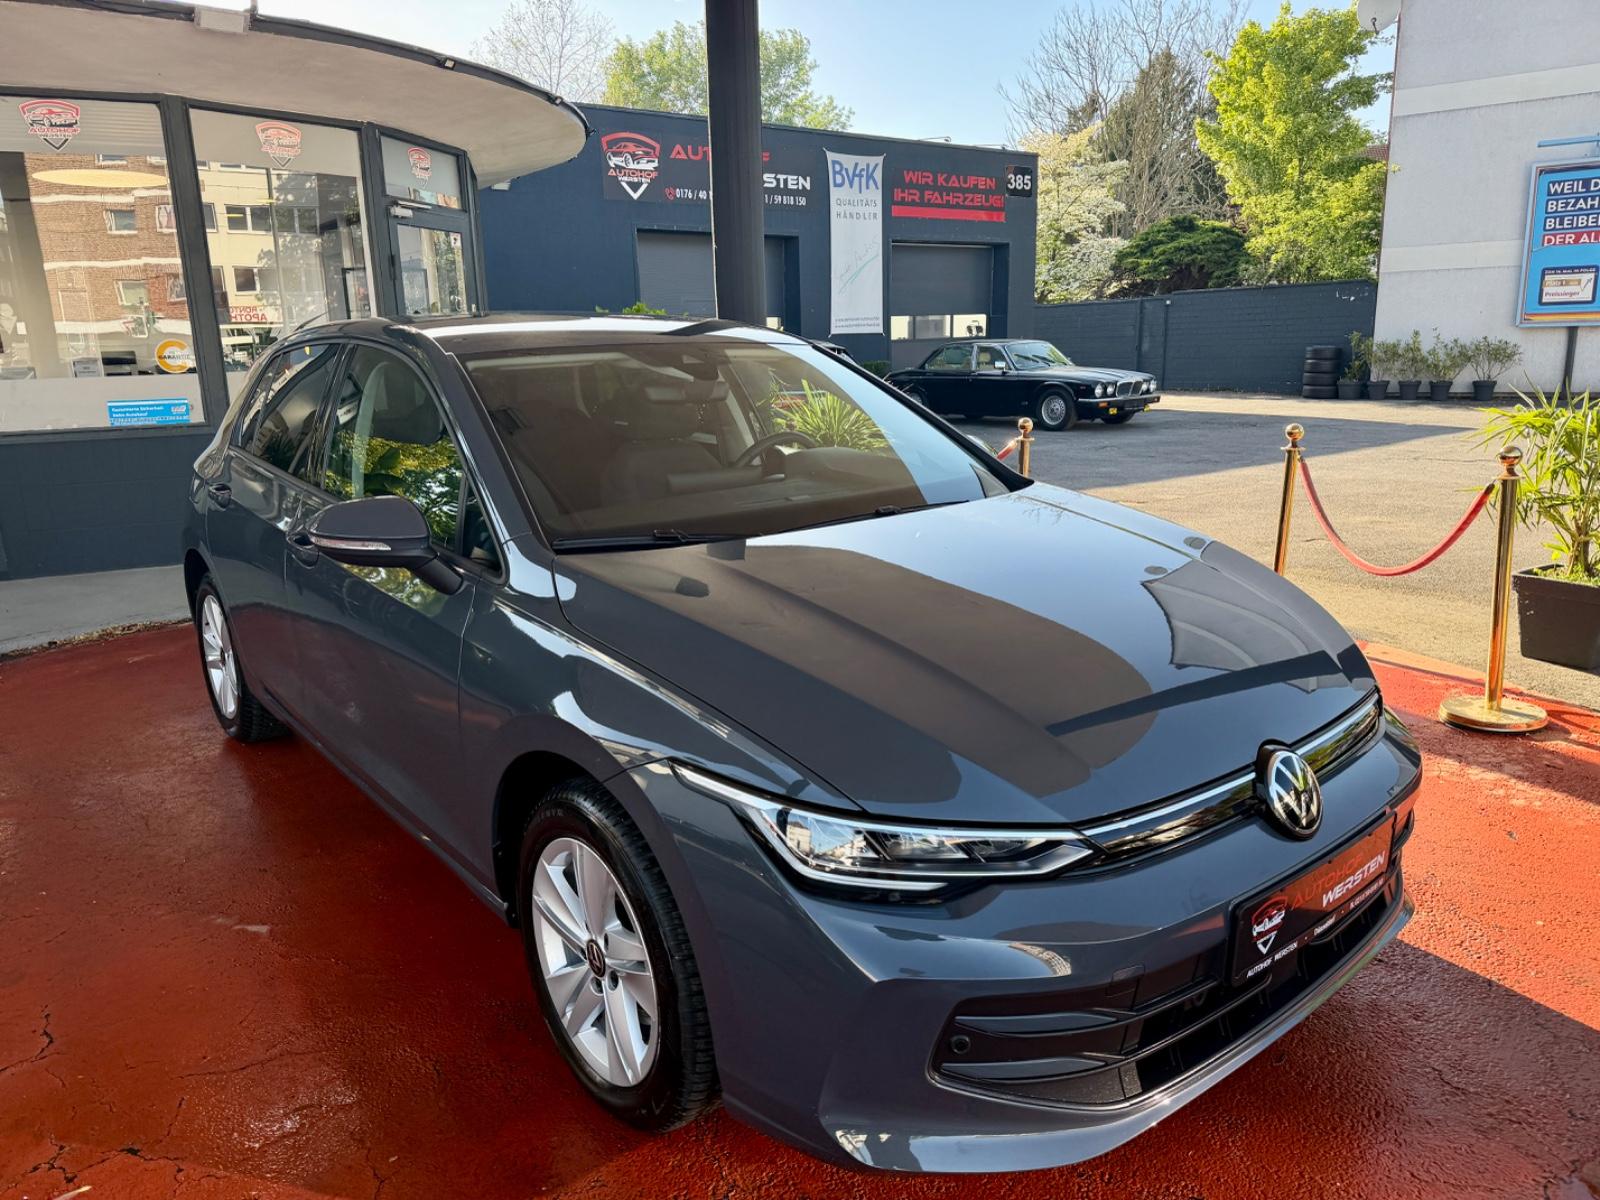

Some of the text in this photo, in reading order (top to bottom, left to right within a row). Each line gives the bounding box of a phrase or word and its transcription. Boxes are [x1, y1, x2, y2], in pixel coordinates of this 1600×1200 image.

[607, 168, 658, 179] AUTOHOF
[903, 170, 996, 190] WIR KAUFEN
[1007, 173, 1032, 190] 385
[1549, 180, 1586, 194] WEIL
[675, 187, 692, 199] 0176
[698, 189, 708, 200] 40
[774, 194, 782, 205] 59
[795, 196, 807, 206] 150
[894, 188, 920, 203] IHR
[1547, 196, 1600, 212] BEZAH
[1544, 233, 1575, 246] DER
[1322, 850, 1386, 908] WERSTEN
